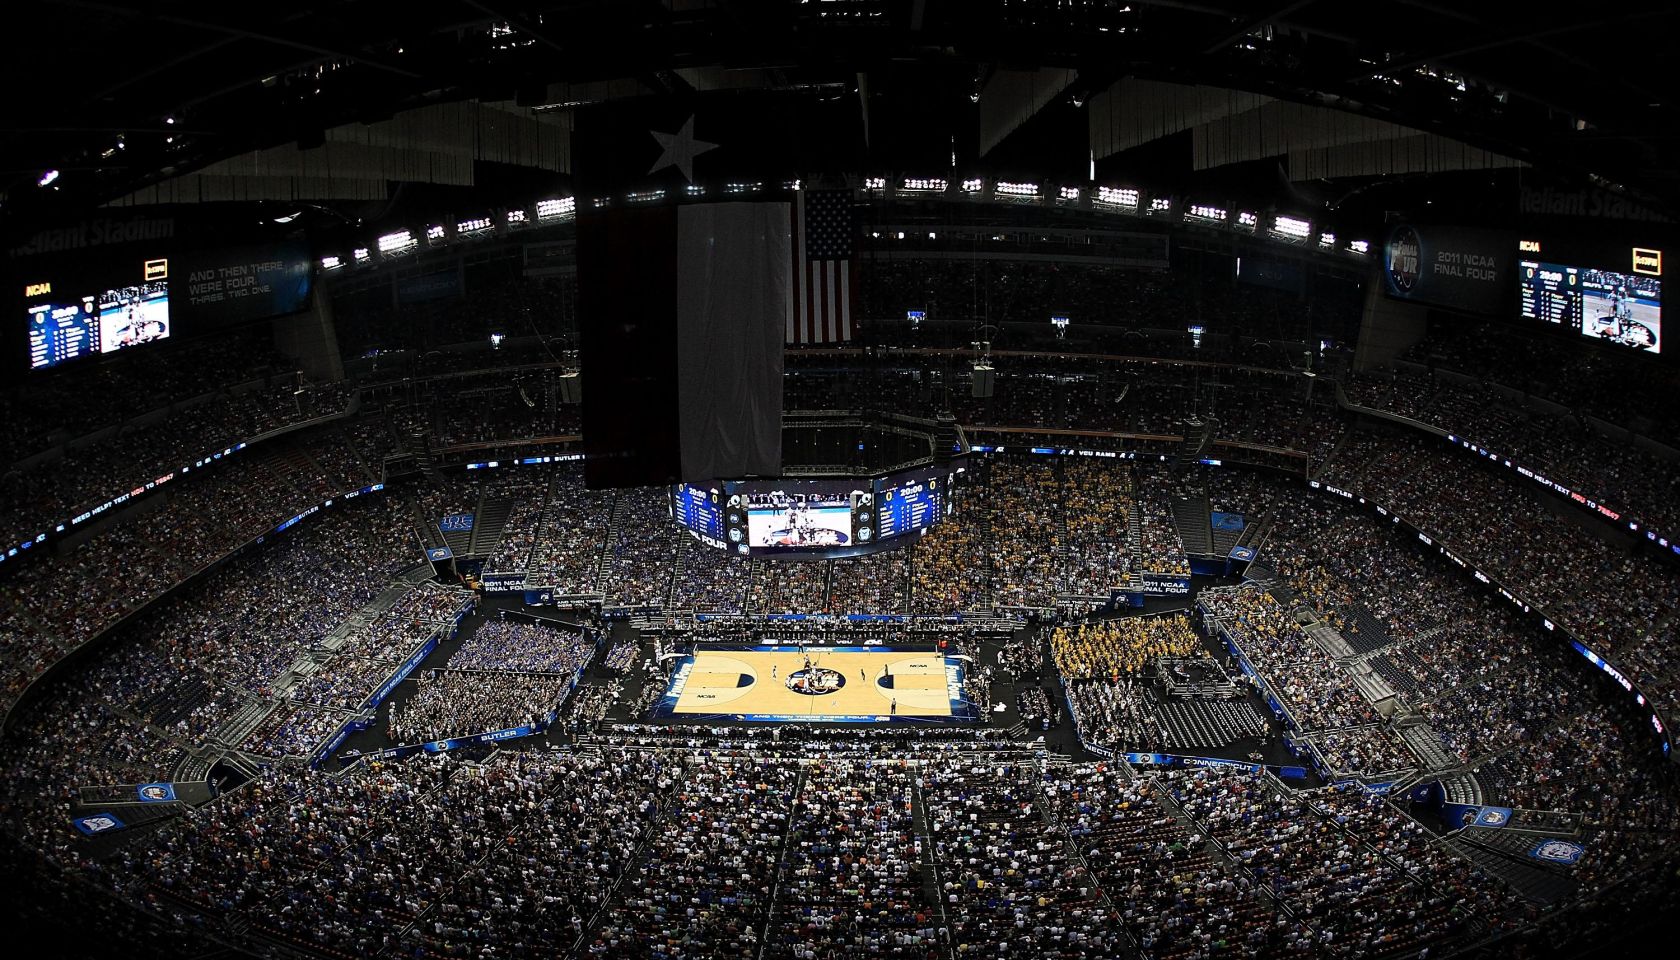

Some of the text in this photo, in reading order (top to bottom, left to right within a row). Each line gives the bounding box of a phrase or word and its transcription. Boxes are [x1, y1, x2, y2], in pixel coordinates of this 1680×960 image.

[1519, 241, 1540, 252] NCAA
[1438, 252, 1496, 268] 2011 NCAA
[189, 260, 283, 283] AND THEN THERE
[1434, 263, 1496, 281] FINAL FOUR
[1526, 268, 1534, 278] 0
[1569, 274, 1576, 286] 0
[26, 282, 51, 297] NCAA
[189, 280, 223, 296] WERE
[900, 485, 923, 496] 20:00
[930, 481, 936, 490] 0
[1326, 485, 1353, 499] BUTLER
[1517, 466, 1533, 478] NEED
[1554, 484, 1570, 496] TEXT
[1587, 499, 1596, 509] TO
[344, 491, 359, 499] VCU
[689, 488, 706, 499] 20:00
[712, 494, 718, 504] 0
[886, 491, 892, 501] 0
[72, 511, 91, 525] NEED
[113, 493, 130, 505] TEXT
[146, 482, 155, 490] TO
[298, 505, 319, 520] BUTLER
[701, 534, 727, 550] FOUR
[1603, 663, 1632, 691] BUTLER
[481, 730, 516, 741] BUTLER
[1183, 758, 1253, 772] CONNECTICUT
